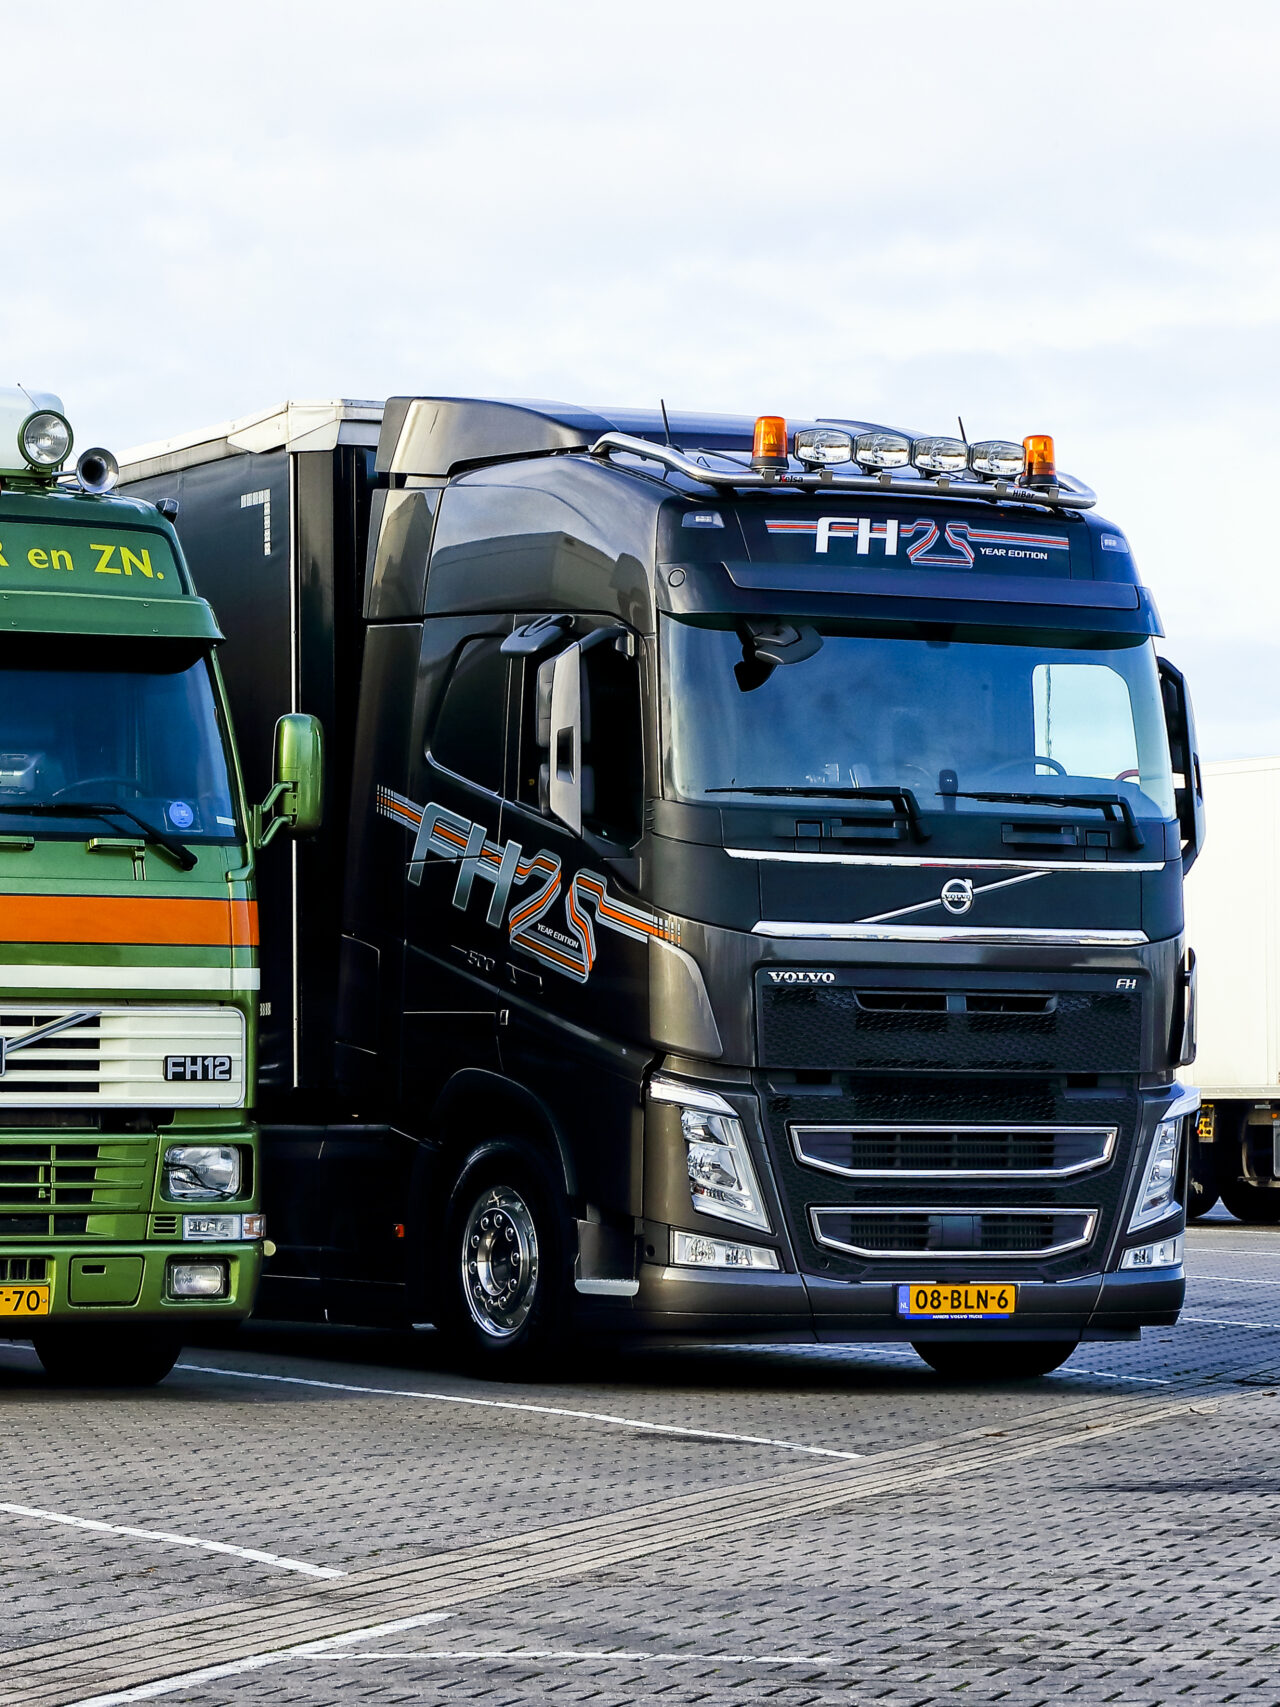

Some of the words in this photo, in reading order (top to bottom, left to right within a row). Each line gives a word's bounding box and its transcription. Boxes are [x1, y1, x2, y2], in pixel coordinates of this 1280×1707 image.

[28, 548, 74, 571] en
[90, 543, 166, 580] ZN.
[980, 547, 1007, 556] YEAR
[1008, 549, 1049, 560] EDITION
[537, 923, 554, 937] YEAR
[553, 931, 579, 949] EDITION
[767, 971, 836, 984] VOLVO
[1115, 978, 1137, 990] FH
[167, 1056, 230, 1080] FH12
[915, 1289, 1008, 1309] 08-BLN-6
